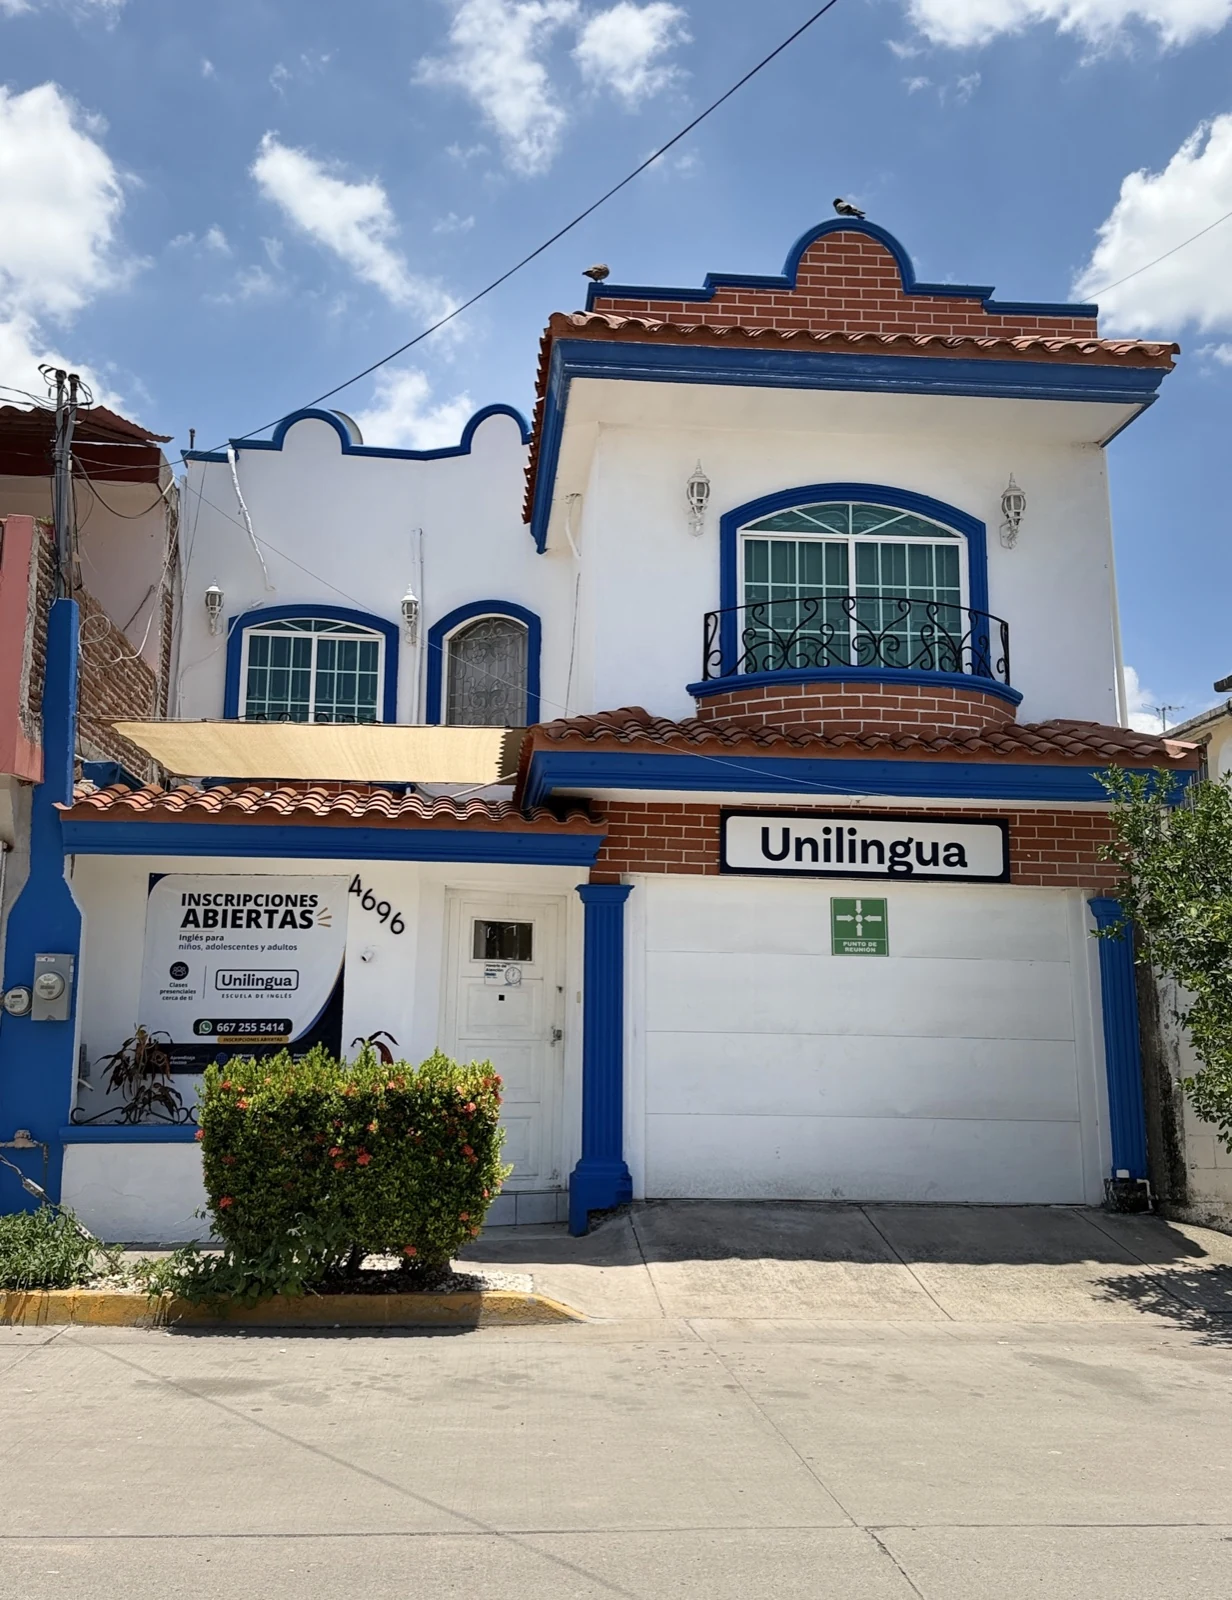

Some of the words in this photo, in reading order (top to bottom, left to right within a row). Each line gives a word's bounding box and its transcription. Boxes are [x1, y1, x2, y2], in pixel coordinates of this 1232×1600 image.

[761, 826, 968, 874] Unilingua
[181, 893, 318, 908] INSCRIPCIONES
[348, 873, 405, 935] 4696
[180, 908, 314, 929] ABIERTAS
[179, 933, 203, 943] Inglés
[205, 935, 224, 943] para
[178, 943, 203, 951] niños,
[205, 943, 259, 951] adolescentes
[267, 943, 298, 951] adultos
[221, 973, 292, 990] Unilingua
[216, 1022, 235, 1032] 667
[238, 1022, 257, 1032] 255
[259, 1022, 285, 1032] 5414
